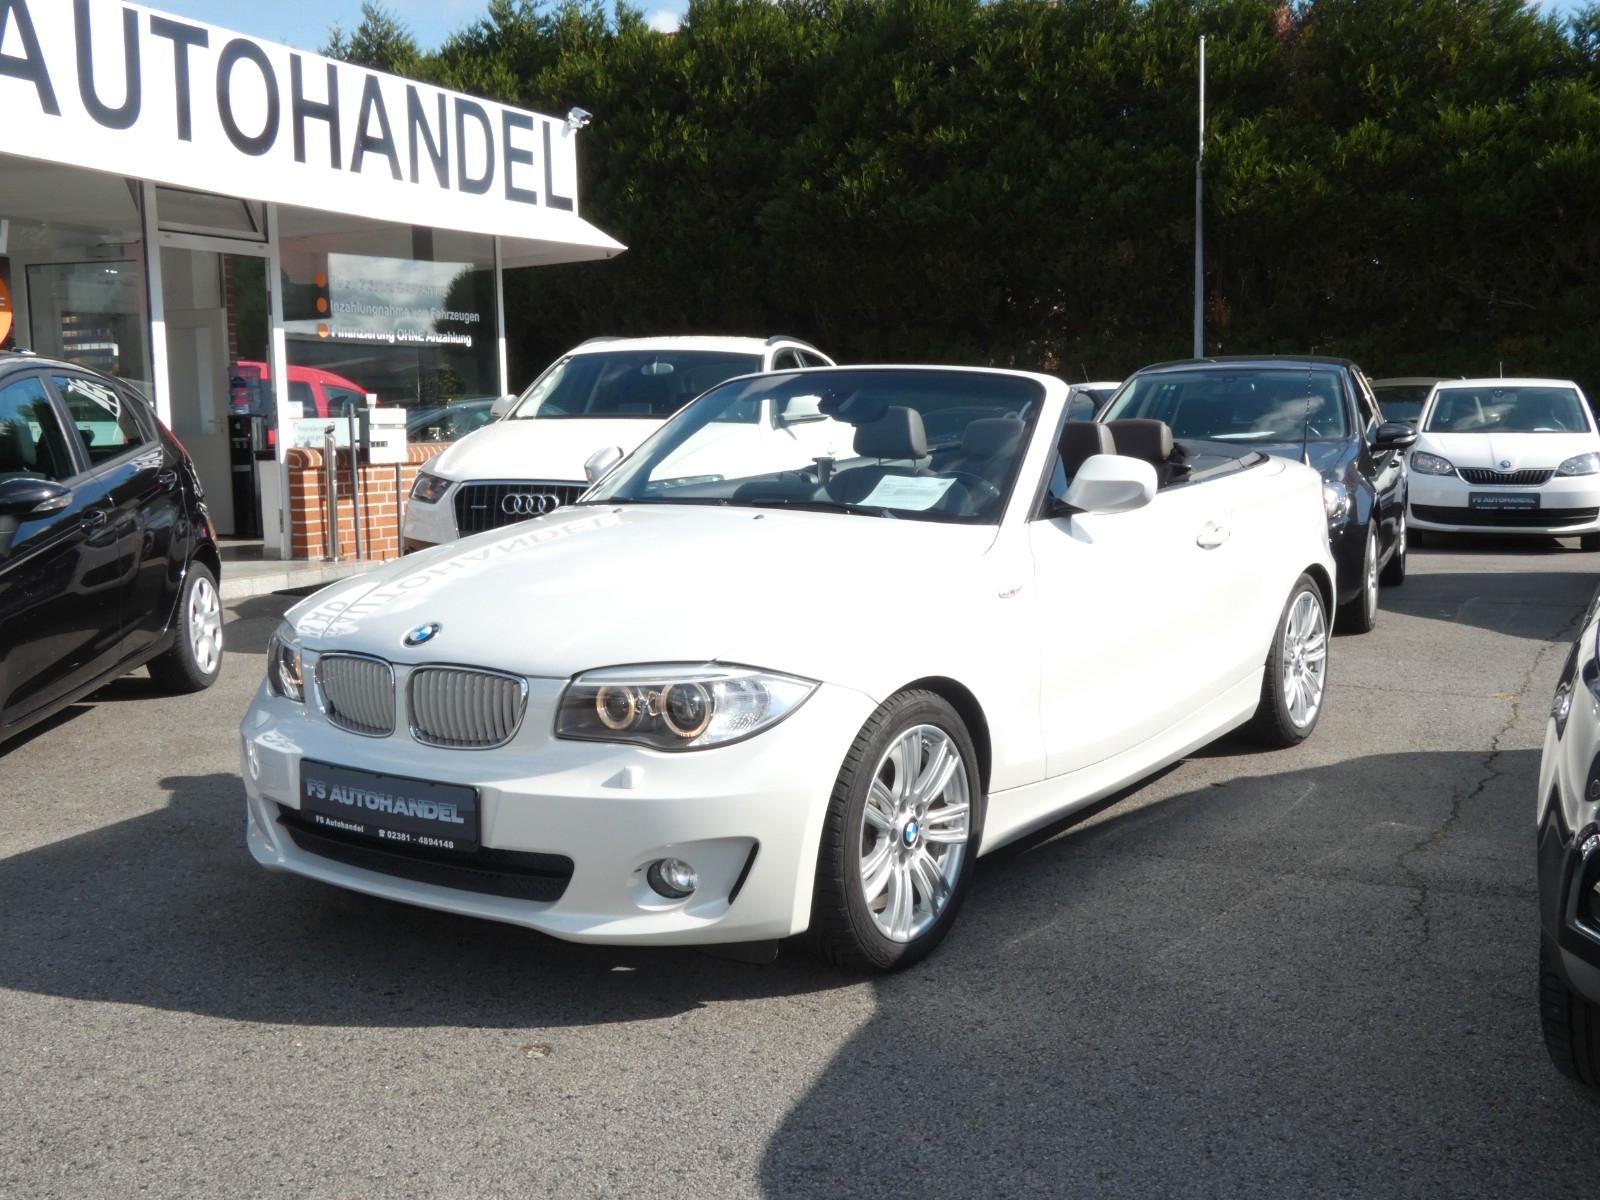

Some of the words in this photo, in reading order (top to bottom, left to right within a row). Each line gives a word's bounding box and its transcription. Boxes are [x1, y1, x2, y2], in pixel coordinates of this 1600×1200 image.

[0, 0, 573, 212] AUTOHANDEL
[430, 307, 480, 324] Fahrzeugen
[397, 329, 425, 342] OHNE
[426, 331, 472, 347] Anzahlung
[306, 779, 326, 799] FS
[330, 784, 464, 824] AUTOHANDEL
[326, 817, 364, 833] Autohandel
[387, 830, 411, 842] 02381
[418, 835, 454, 849] 4894148
